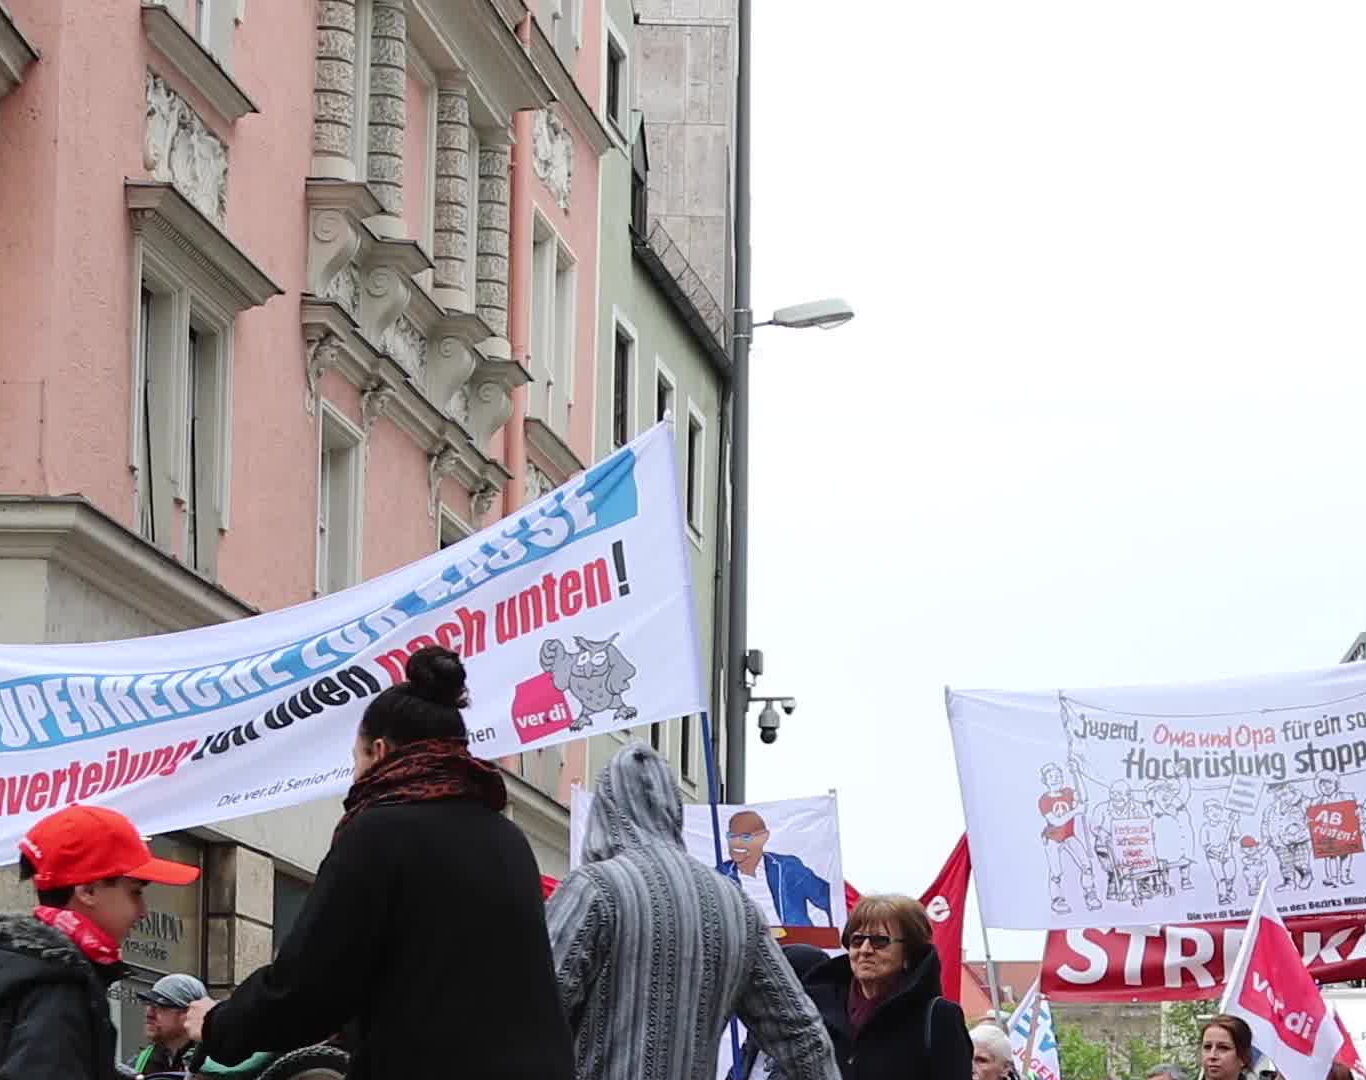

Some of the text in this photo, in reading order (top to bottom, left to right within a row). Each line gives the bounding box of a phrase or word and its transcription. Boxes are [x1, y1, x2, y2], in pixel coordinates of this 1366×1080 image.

[515, 702, 568, 729] ver.di
[1152, 723, 1196, 748] Oma
[1198, 726, 1233, 748] und
[1233, 724, 1277, 752] Opa
[1281, 719, 1311, 743] für
[1314, 713, 1343, 738] ein
